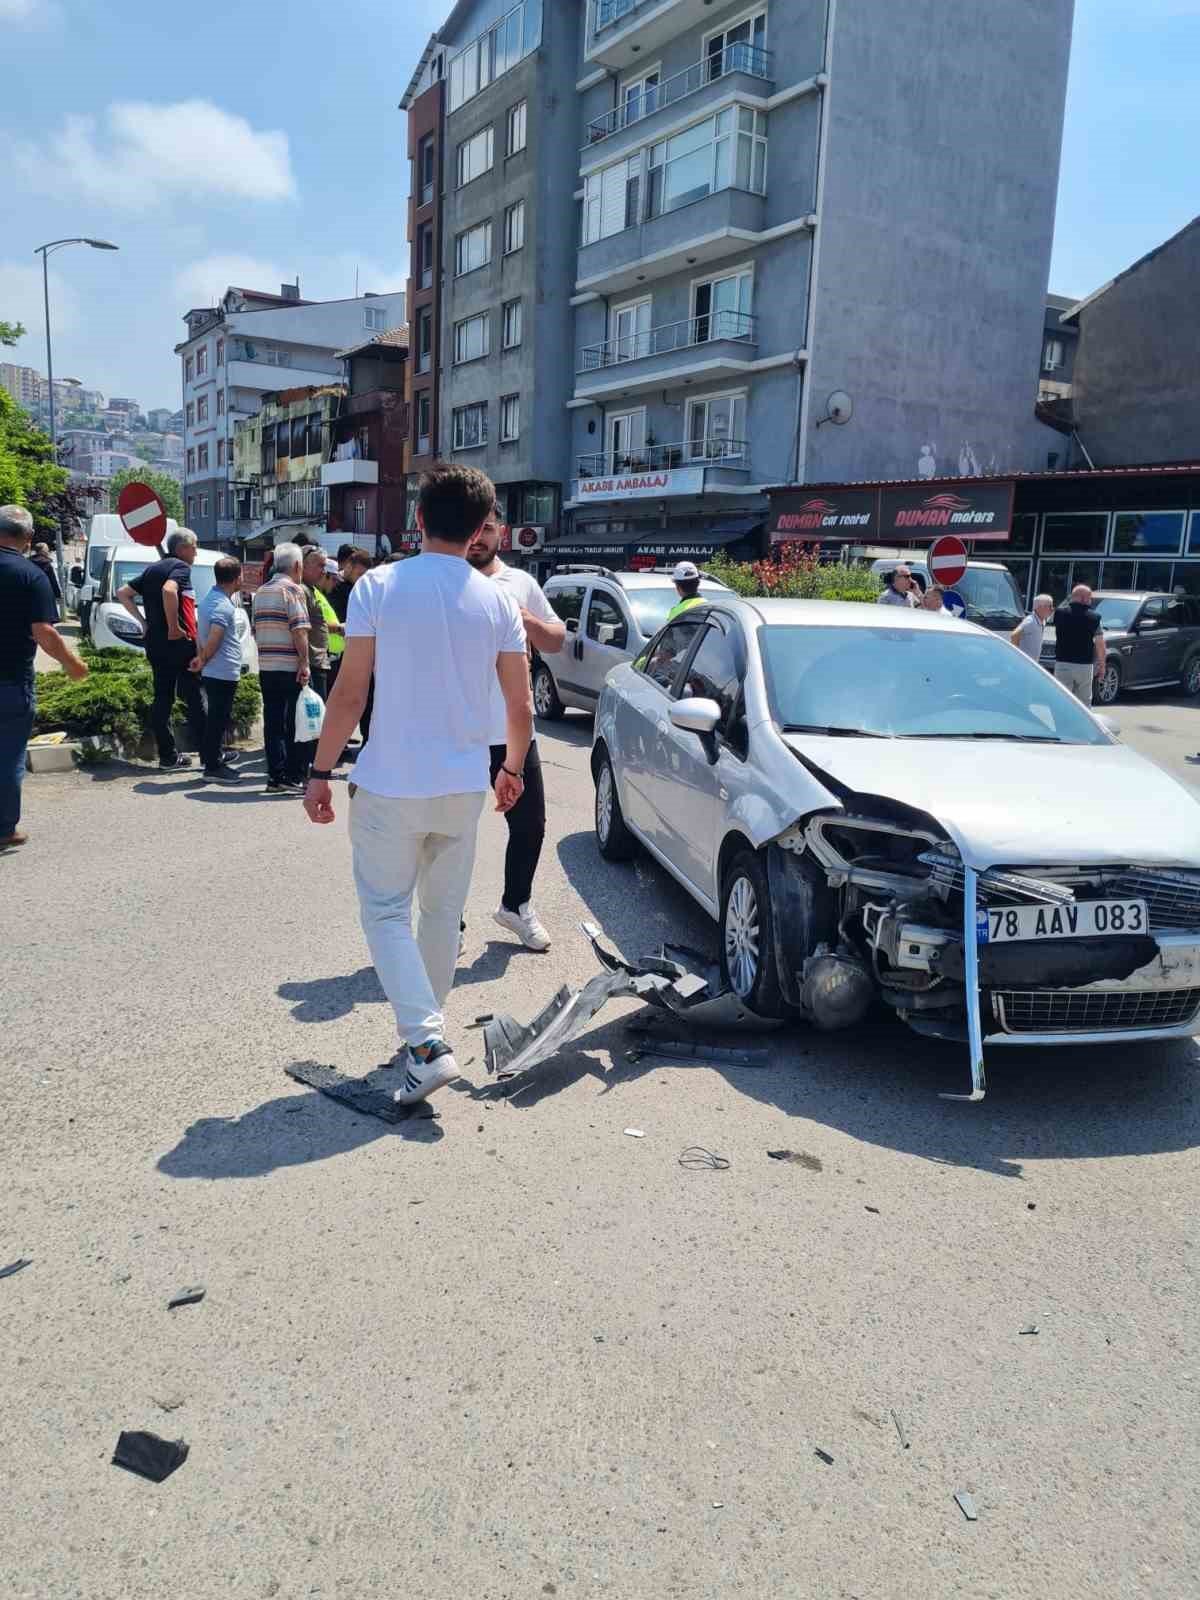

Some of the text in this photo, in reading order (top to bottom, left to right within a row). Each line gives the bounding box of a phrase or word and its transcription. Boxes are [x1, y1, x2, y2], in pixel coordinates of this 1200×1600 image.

[616, 474, 669, 490] AMBALAJ
[777, 512, 871, 529] DUMAN car rental
[895, 510, 995, 527] DUMAN motors
[668, 546, 714, 554] AMBALAJ
[990, 904, 1142, 939] 78 AAV 083
